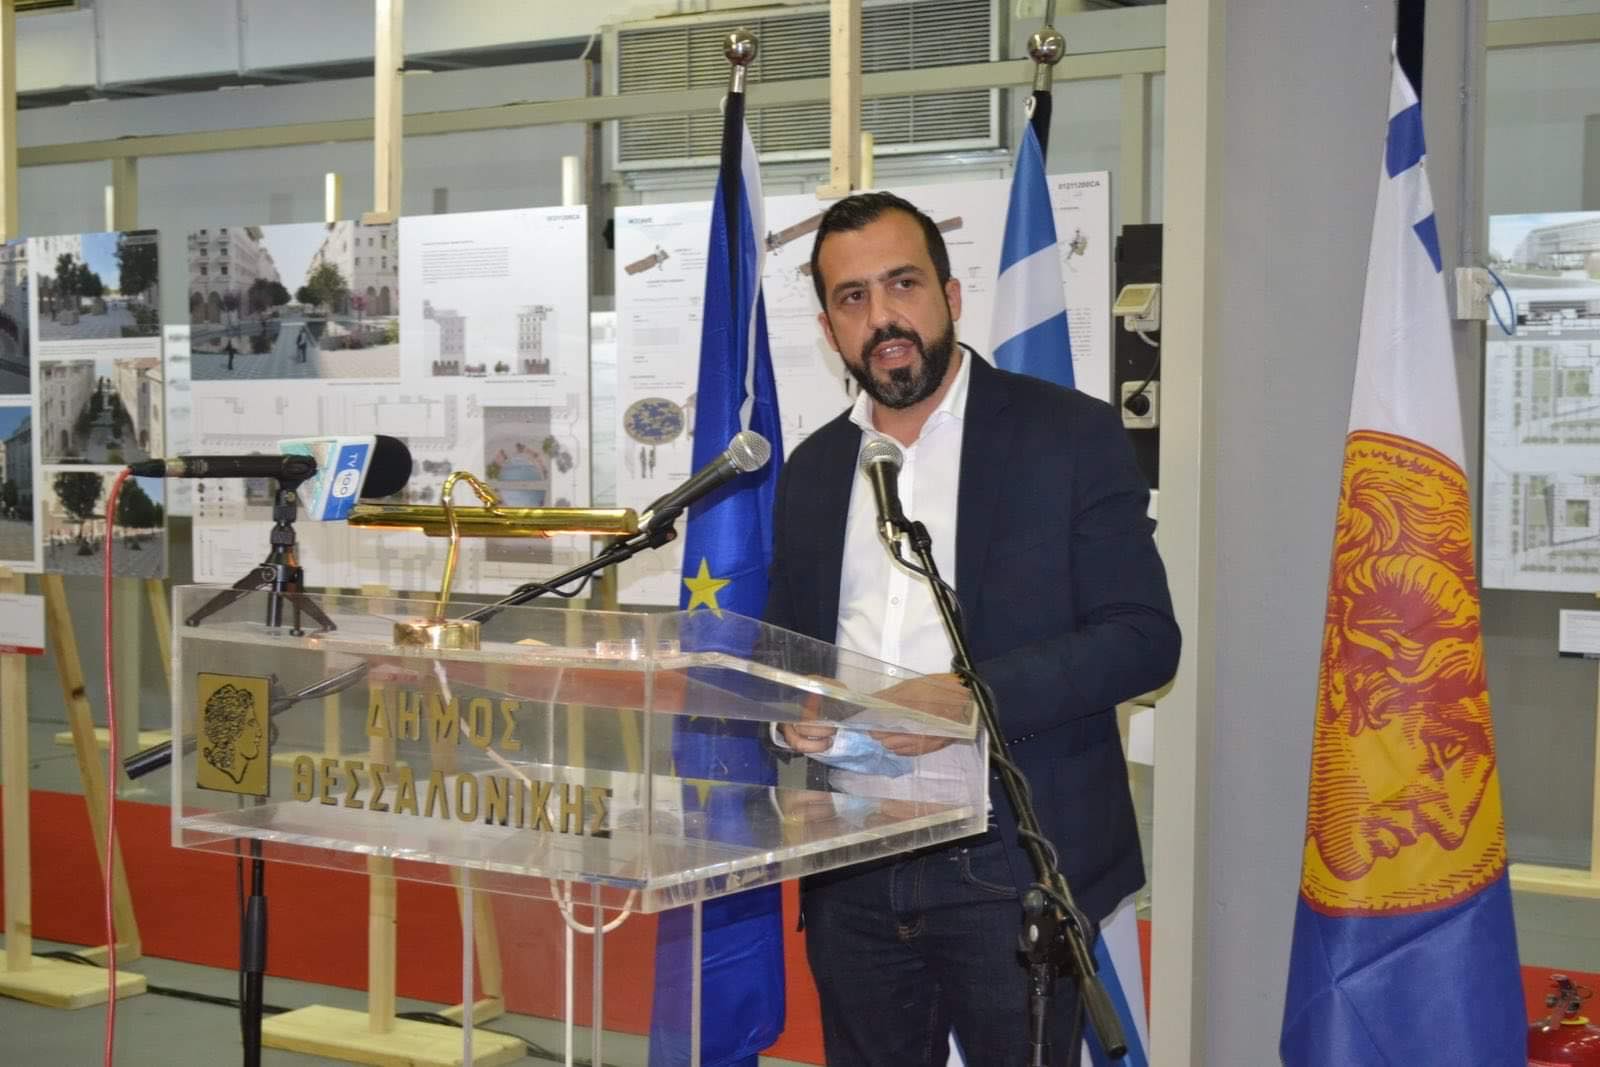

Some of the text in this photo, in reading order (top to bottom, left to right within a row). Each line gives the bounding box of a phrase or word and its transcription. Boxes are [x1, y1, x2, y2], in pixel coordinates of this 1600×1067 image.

[340, 452, 358, 495] TV 100
[366, 687, 522, 751] ΔΗΜΟΣ
[293, 755, 613, 838] ΘΕΣΣΑΛΟΝΙΚΗΣ
